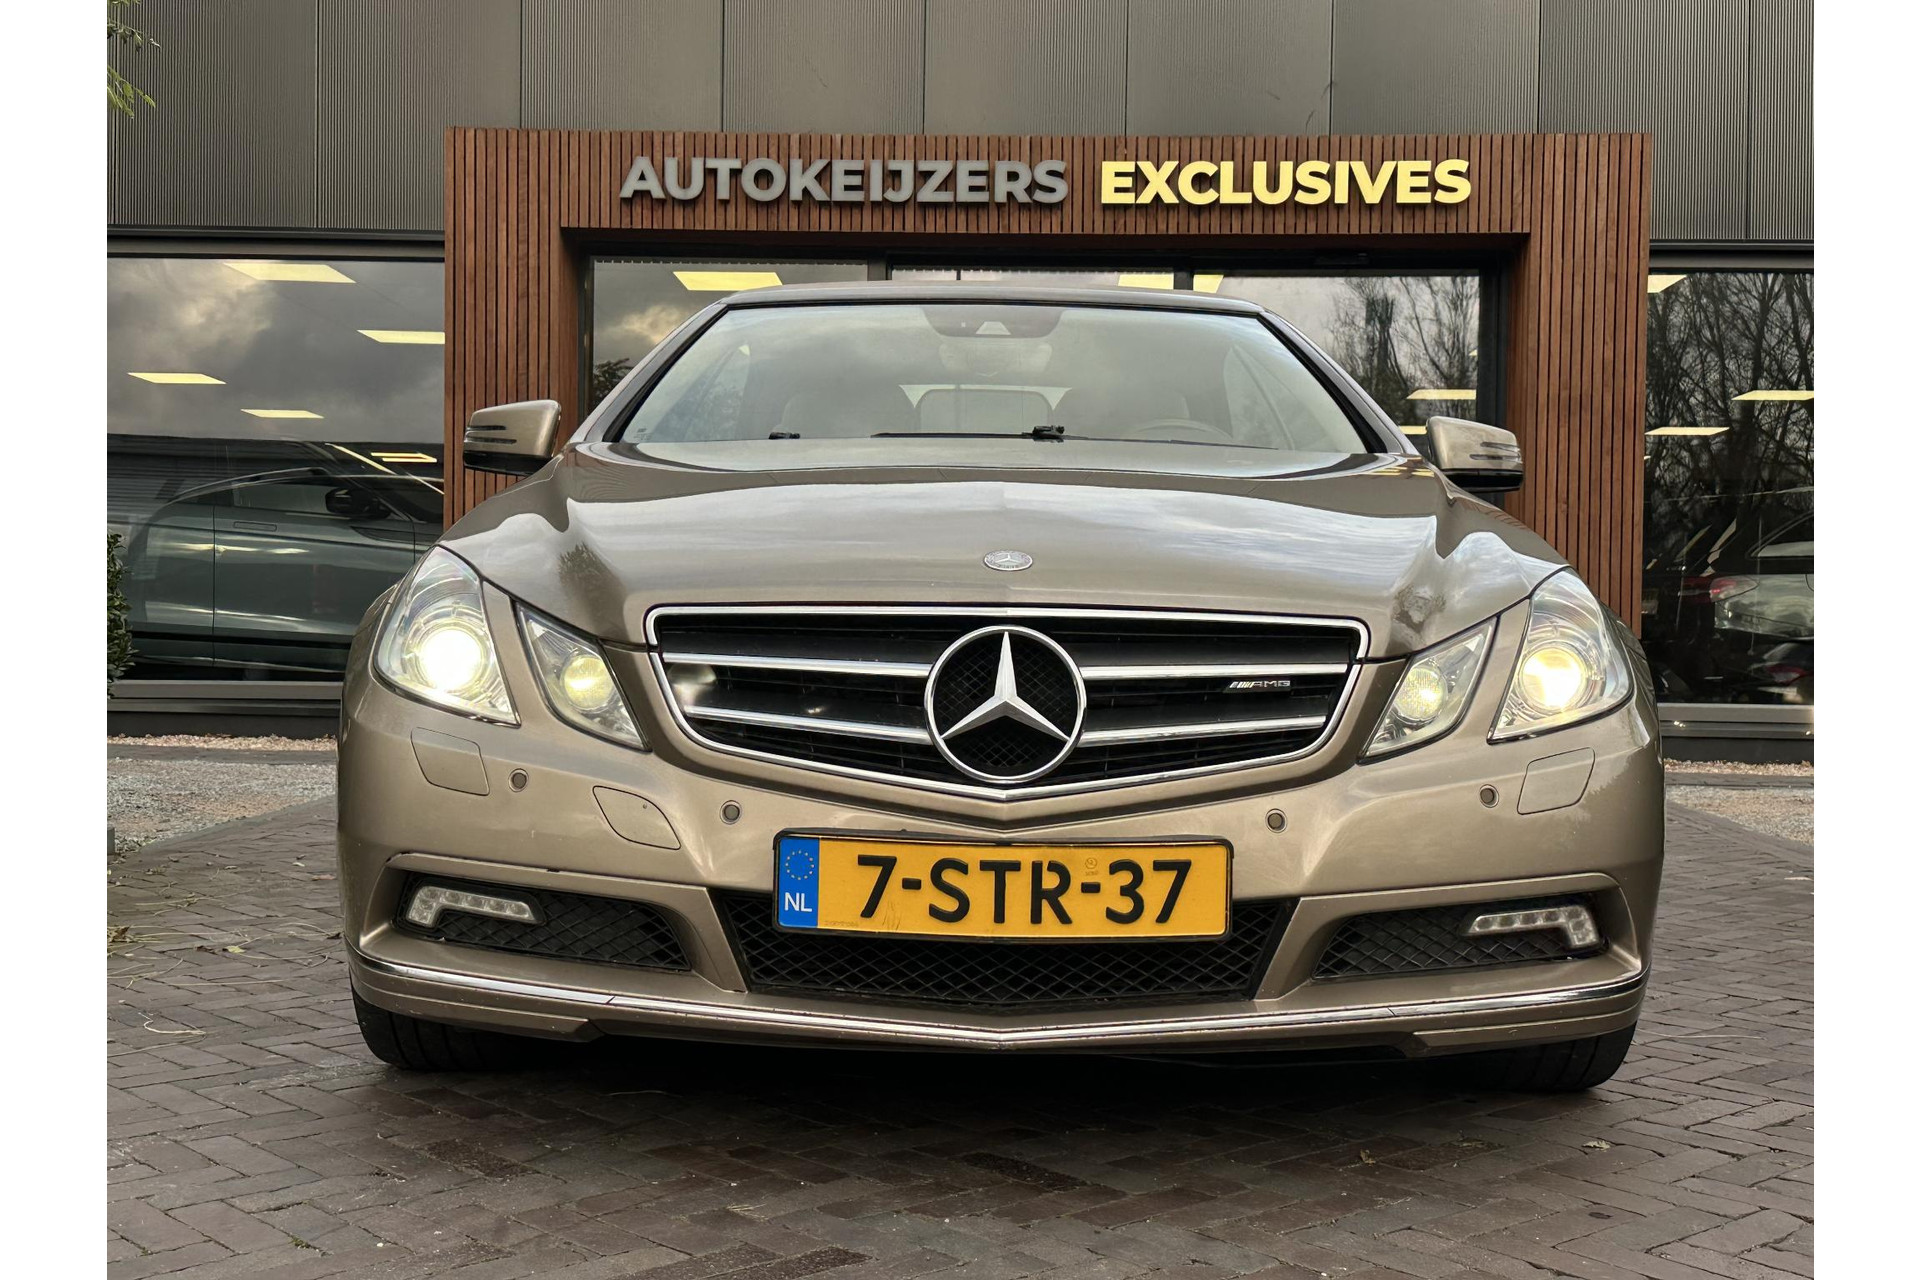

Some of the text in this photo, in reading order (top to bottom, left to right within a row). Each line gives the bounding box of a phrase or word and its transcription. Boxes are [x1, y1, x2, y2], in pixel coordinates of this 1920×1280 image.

[619, 156, 1472, 205] AUTOKEIJZERS EXCLUSIVES
[1250, 680, 1291, 688] AMG
[784, 892, 812, 913] NL
[857, 854, 1192, 925] 7-STR-37
